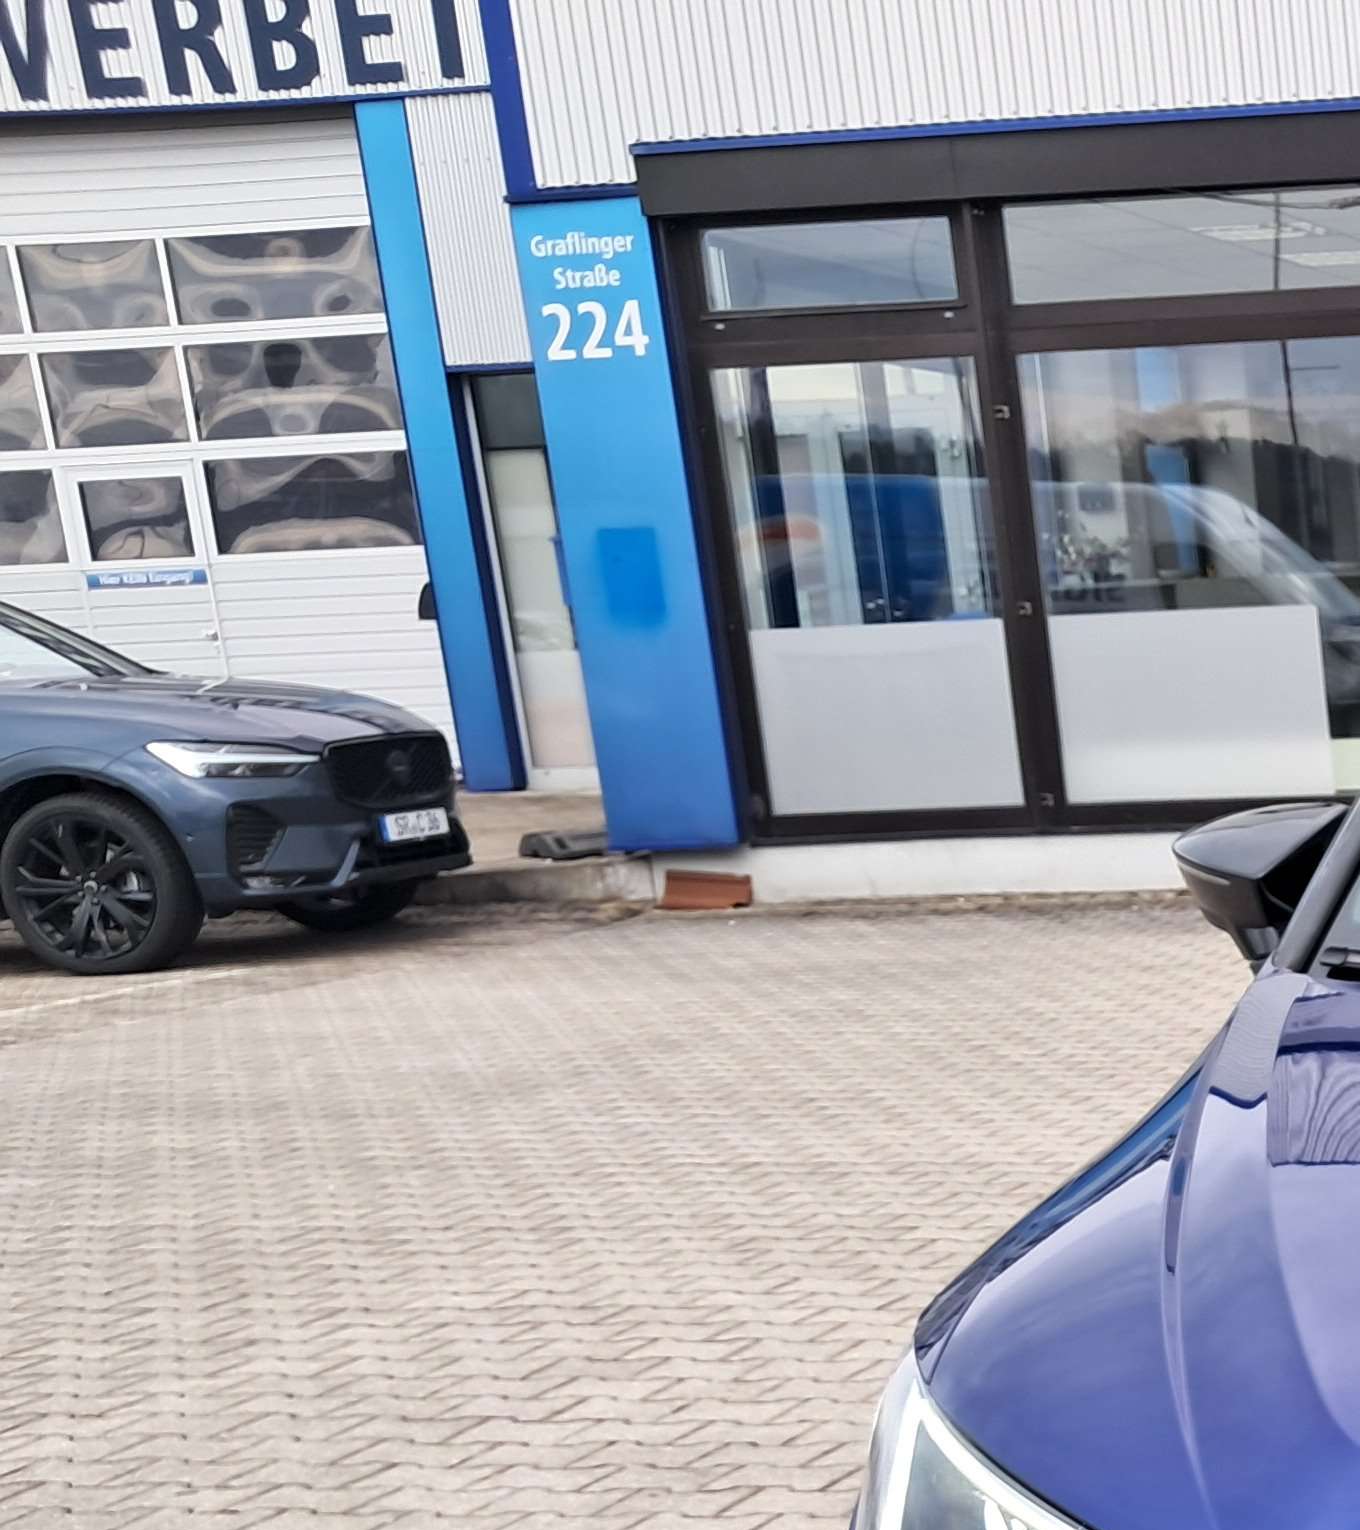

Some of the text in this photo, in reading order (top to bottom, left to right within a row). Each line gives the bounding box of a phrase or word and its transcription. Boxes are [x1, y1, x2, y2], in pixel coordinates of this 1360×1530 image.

[530, 231, 634, 259] Graflinger
[553, 263, 621, 290] Straße
[541, 299, 650, 361] 224
